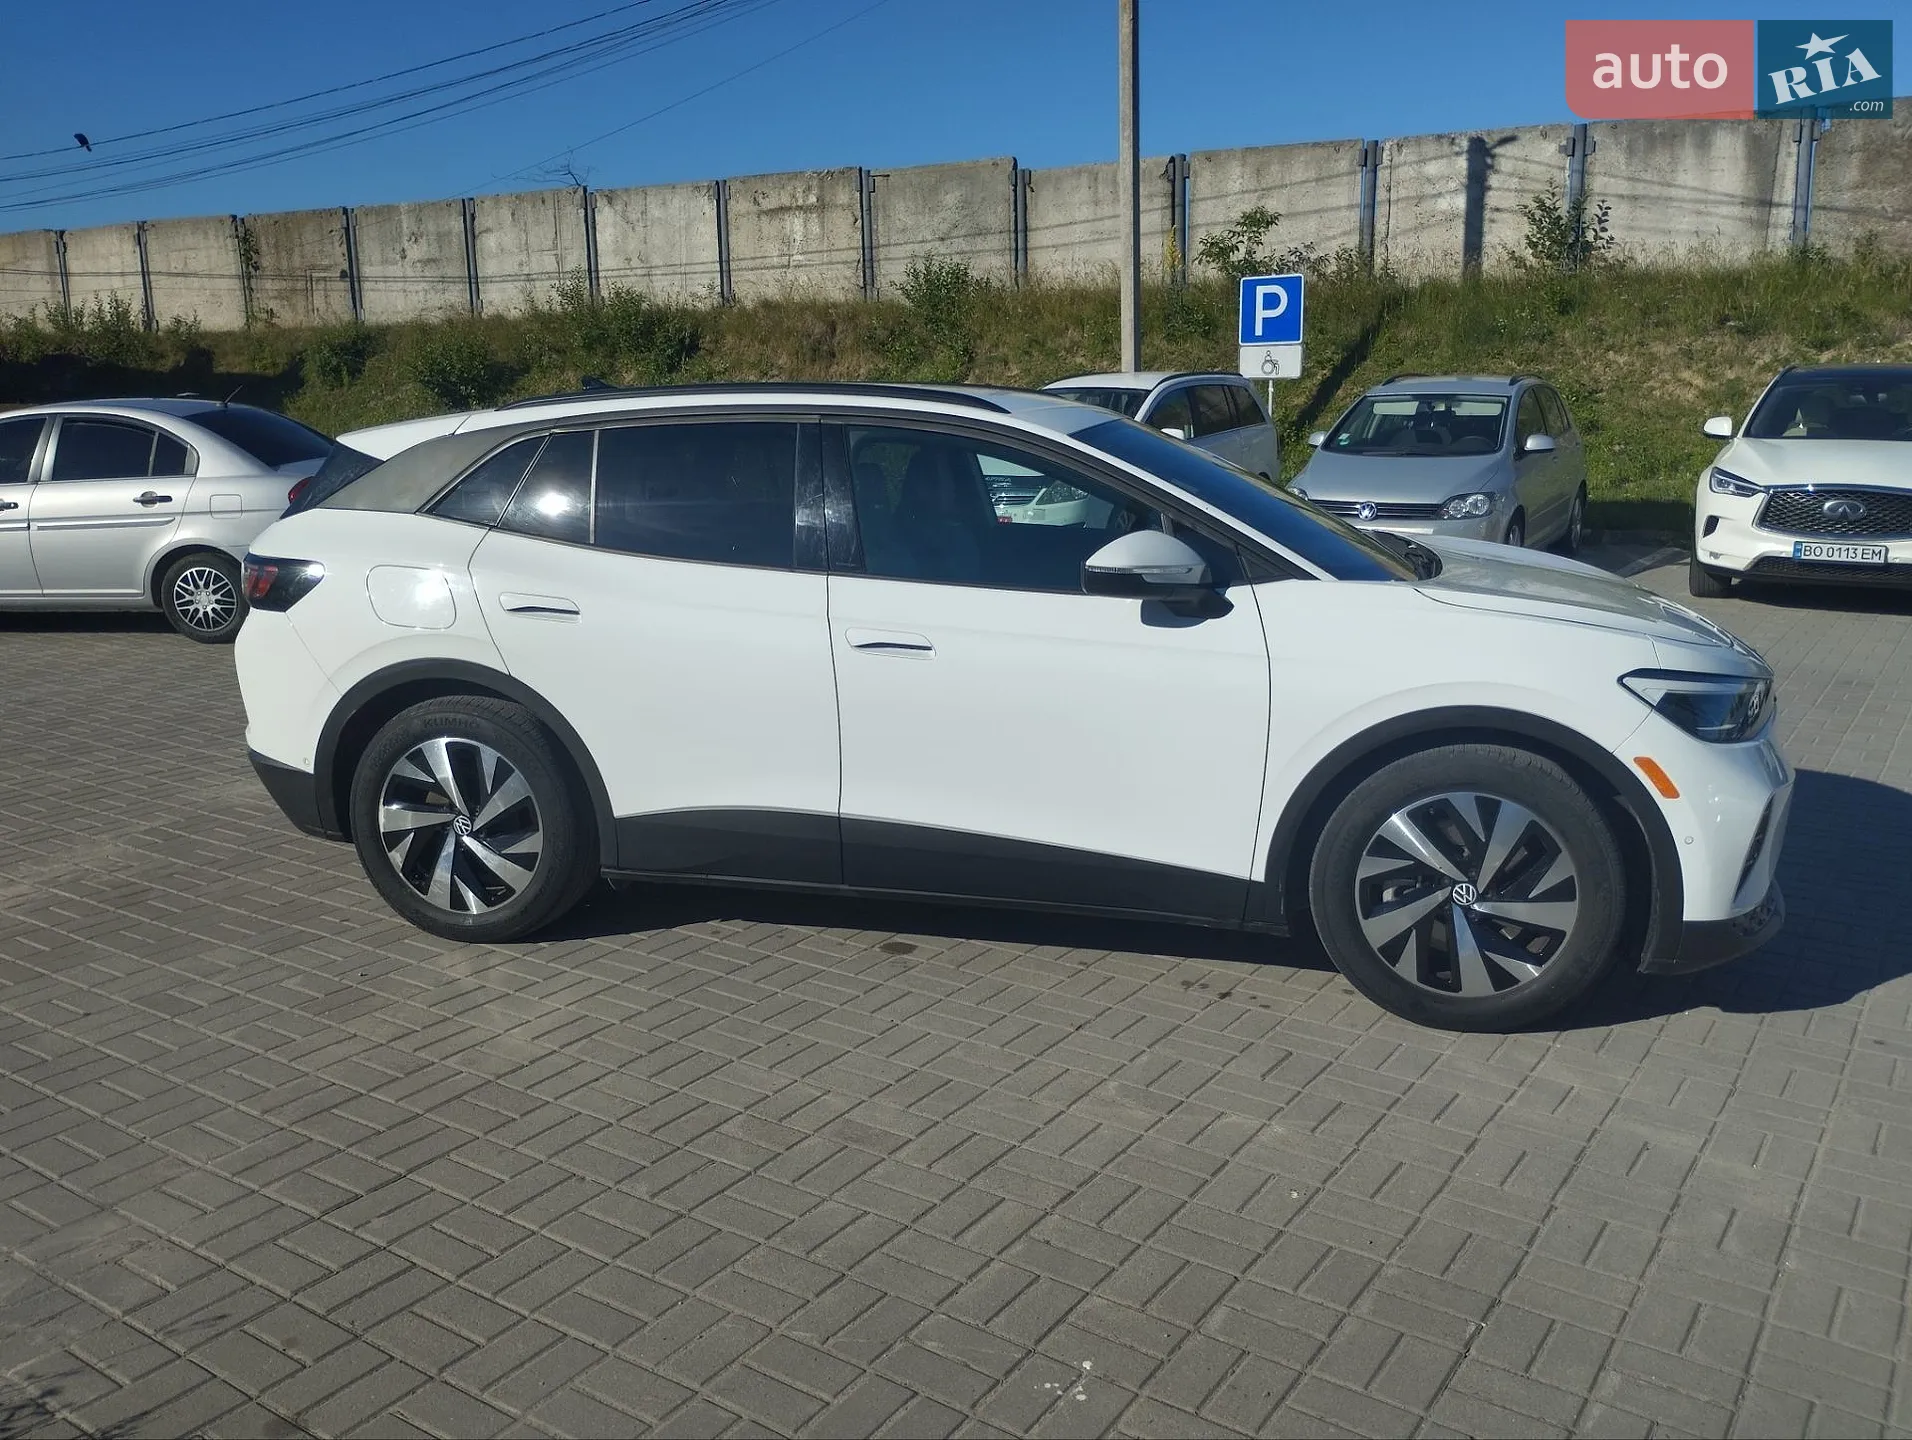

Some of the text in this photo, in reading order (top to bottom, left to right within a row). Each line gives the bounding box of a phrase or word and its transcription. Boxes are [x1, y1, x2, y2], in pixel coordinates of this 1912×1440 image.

[1254, 284, 1288, 336] P
[1803, 545, 1823, 557] BO
[1826, 546, 1858, 559] 0113
[1861, 548, 1882, 560] EM
